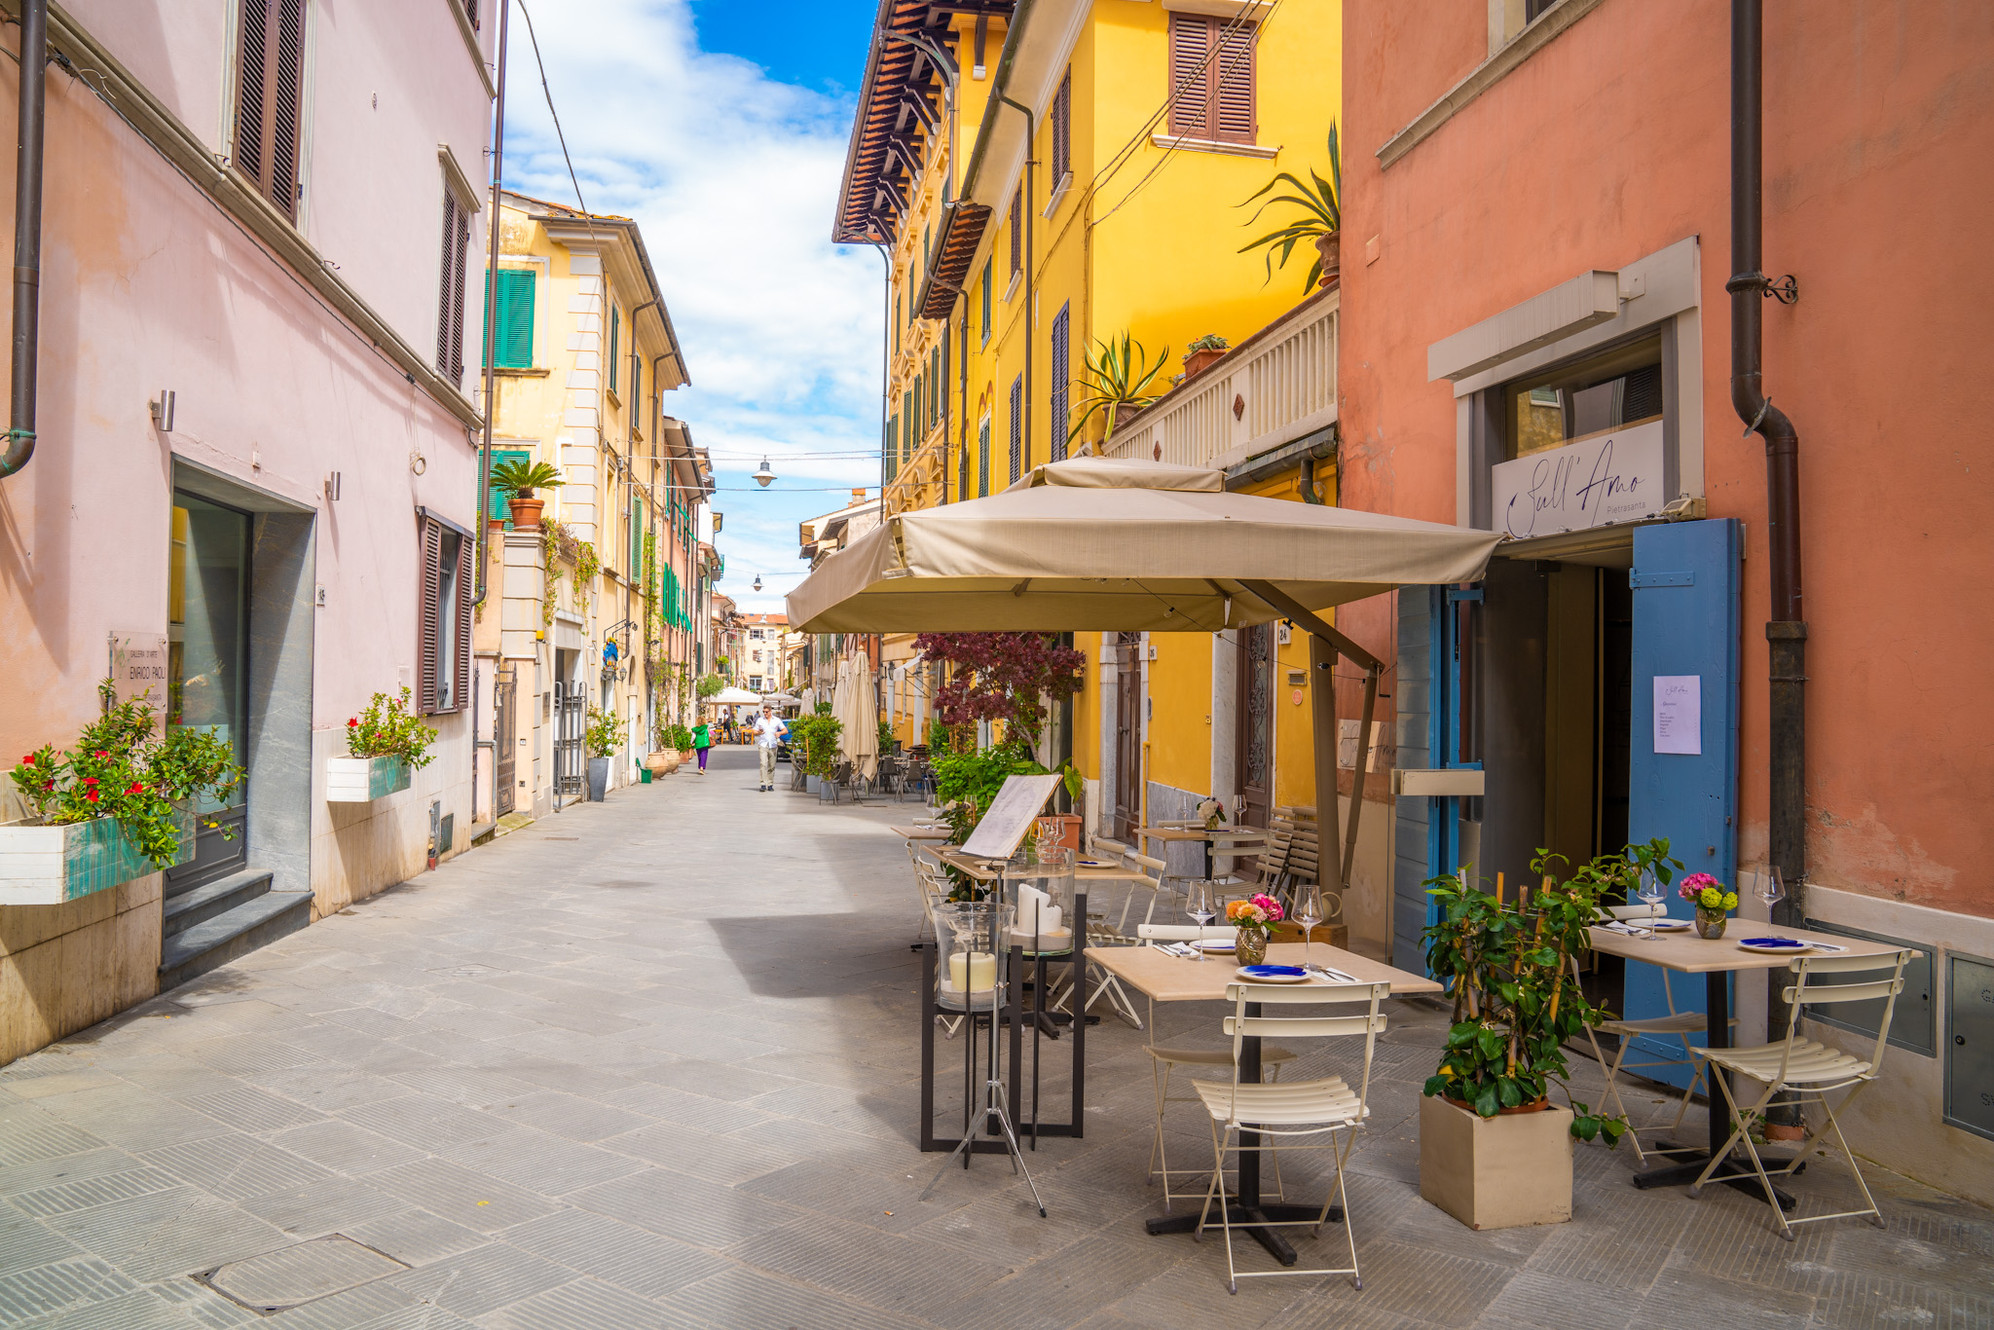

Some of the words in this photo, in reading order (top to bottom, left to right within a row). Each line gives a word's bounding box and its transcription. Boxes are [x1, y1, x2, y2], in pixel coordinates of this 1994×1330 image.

[1607, 501, 1647, 515] Pietrasanta
[1279, 628, 1287, 641] 24
[130, 666, 150, 680] ENRICO
[152, 666, 167, 680] PAOLI
